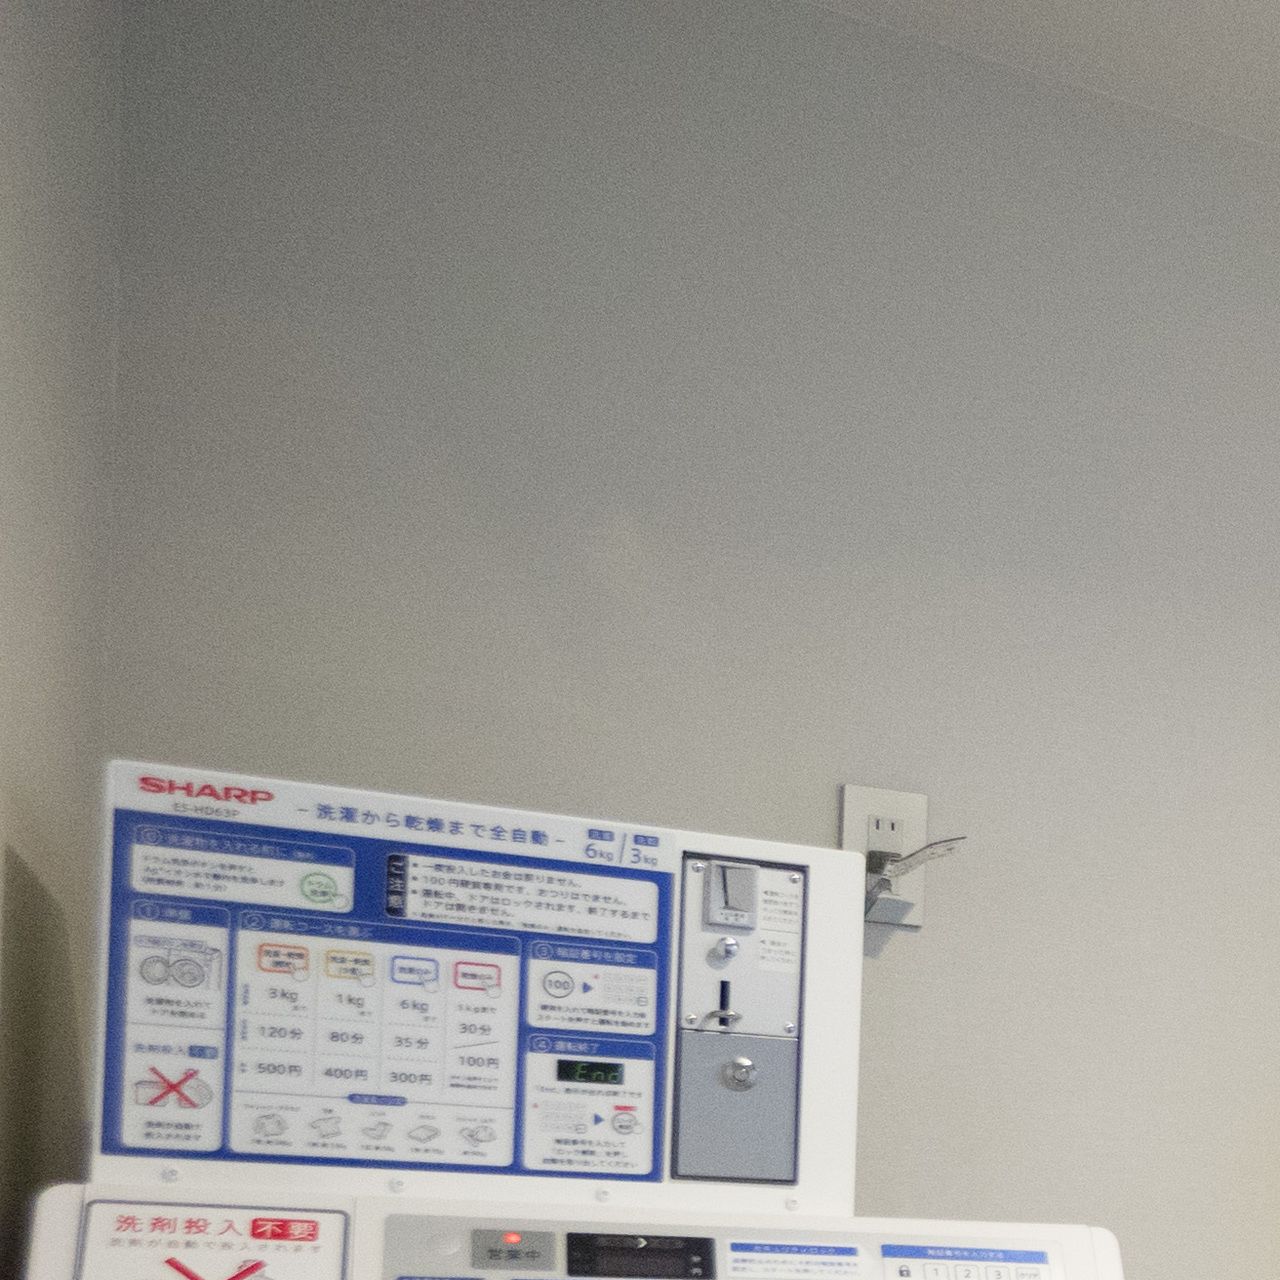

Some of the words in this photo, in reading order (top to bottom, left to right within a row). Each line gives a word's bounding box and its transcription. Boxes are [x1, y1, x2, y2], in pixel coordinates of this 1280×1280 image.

[137, 775, 274, 804] SHARP
[315, 802, 549, 847] 洗濯から乾燥まで全自動
[583, 842, 616, 863] 6kg
[630, 848, 660, 867] 3kg
[258, 1026, 305, 1041] 120分
[329, 1031, 365, 1045] 80分
[257, 1062, 303, 1077] 500円
[457, 1056, 500, 1070] 100円
[323, 1068, 369, 1082] 400円
[389, 1072, 433, 1085] 300円
[114, 1214, 244, 1237] 洗剤投入
[255, 1219, 319, 1242] 不要
[964, 1268, 972, 1279] 2
[995, 1270, 1003, 1280] 3
